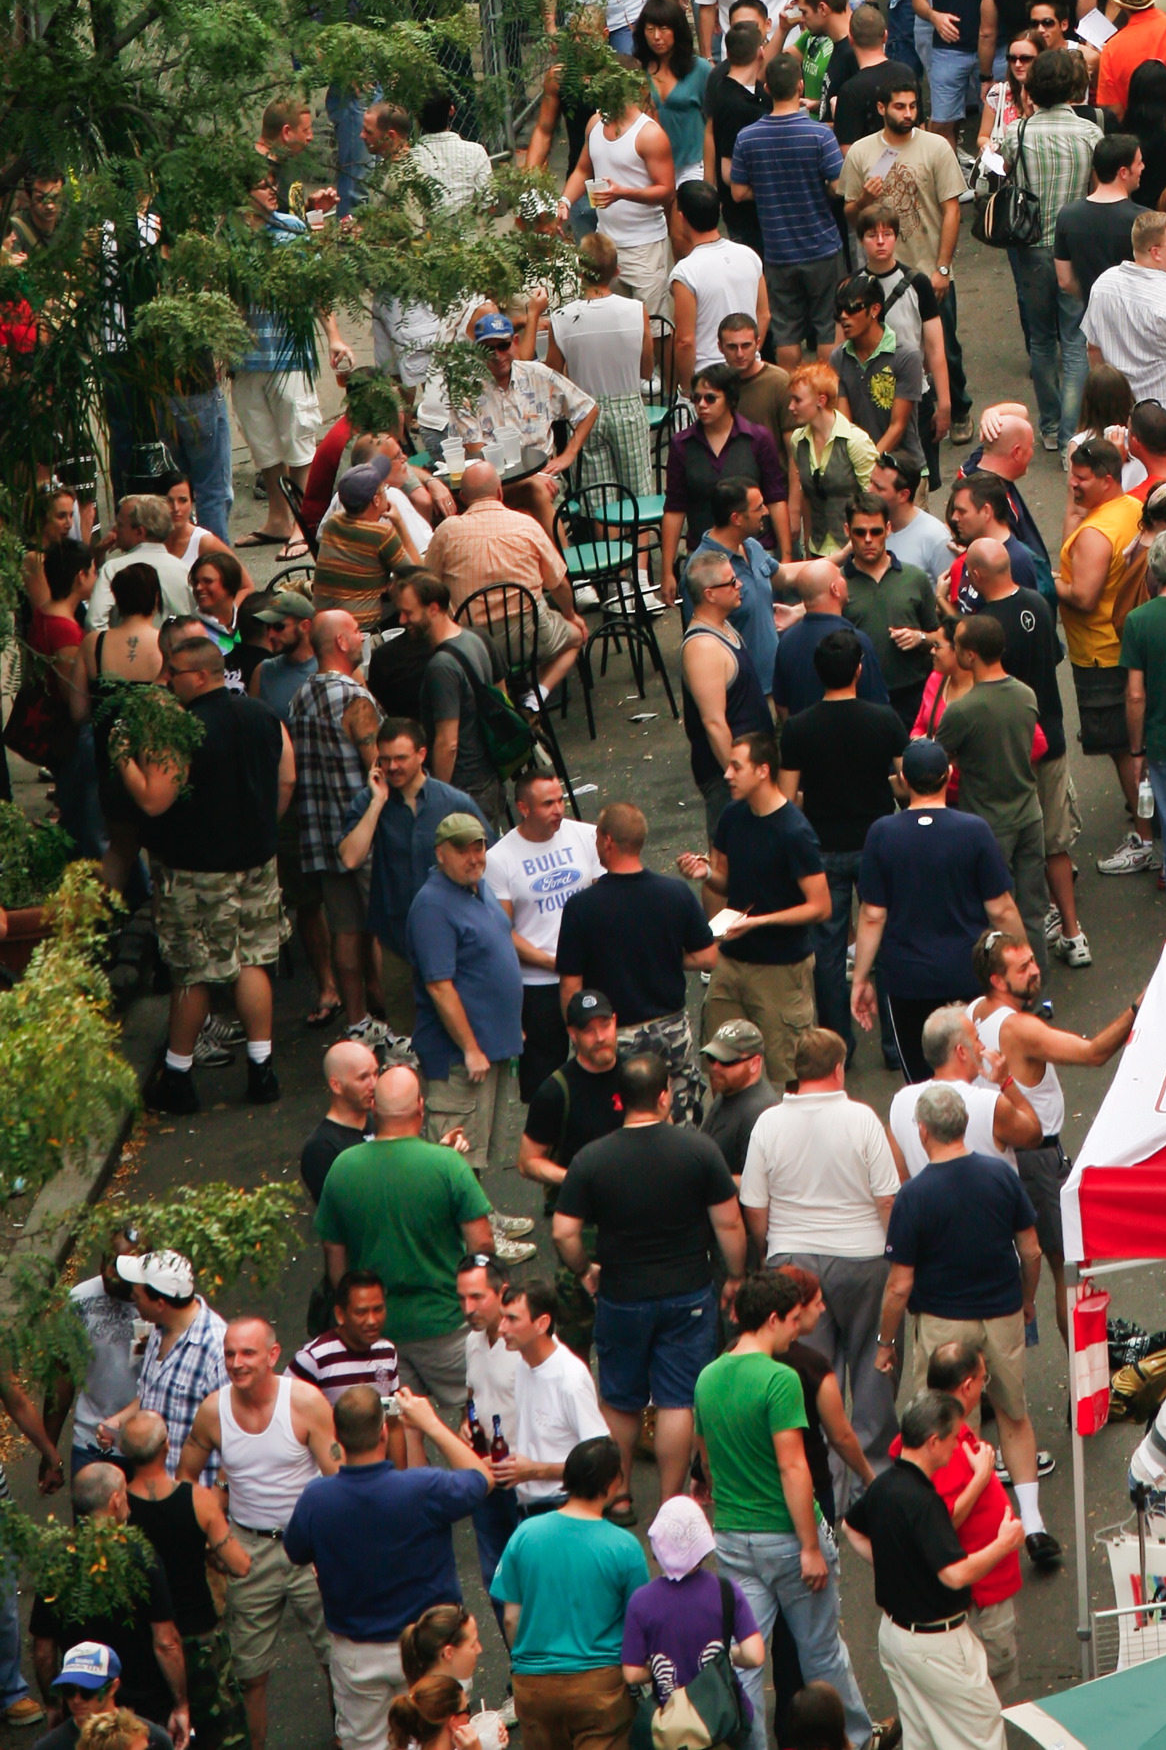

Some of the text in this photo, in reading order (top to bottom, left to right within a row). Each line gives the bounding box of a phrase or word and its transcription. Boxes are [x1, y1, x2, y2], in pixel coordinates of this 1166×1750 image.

[522, 846, 574, 876] BUILT
[541, 871, 573, 891] Ford
[534, 886, 585, 914] TOU
